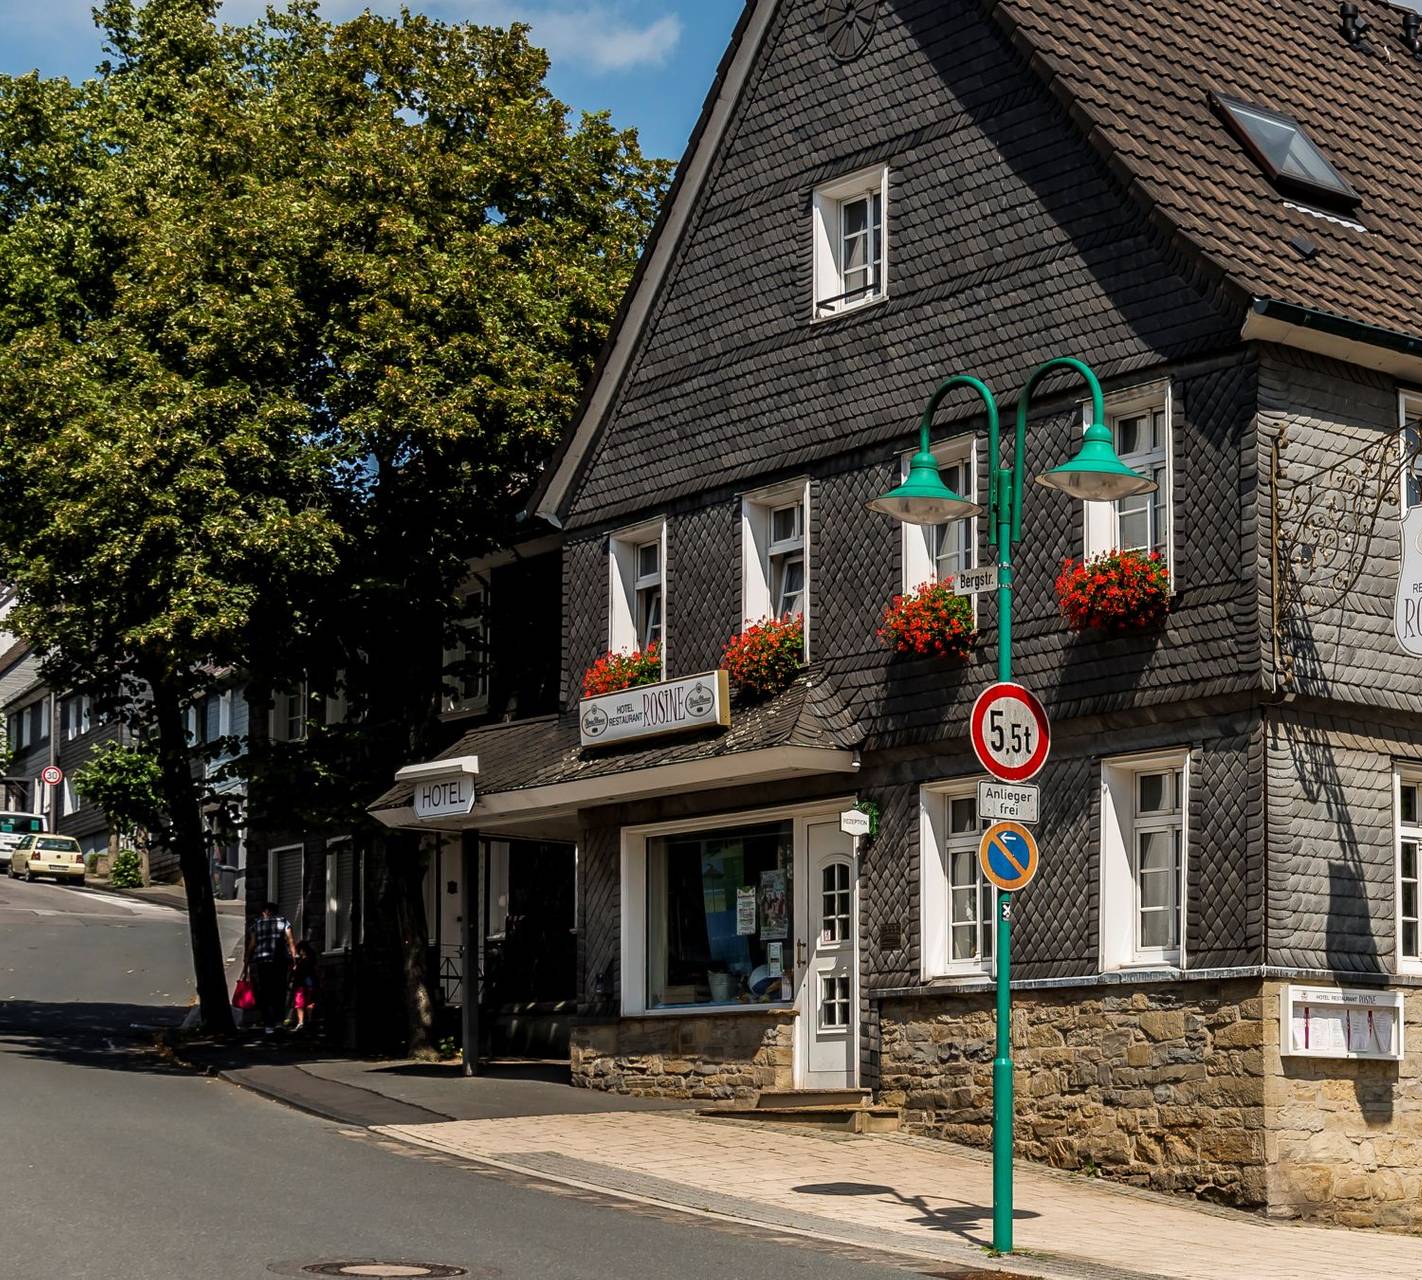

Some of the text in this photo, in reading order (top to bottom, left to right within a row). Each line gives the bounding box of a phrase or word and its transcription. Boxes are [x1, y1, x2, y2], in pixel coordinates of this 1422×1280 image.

[960, 571, 994, 590] Bergstr.
[616, 703, 635, 714] HOTEL
[608, 711, 643, 727] RESTAURANT
[46, 771, 57, 780] 30
[422, 781, 466, 809] HOTEL
[985, 788, 1032, 803] Anlieger
[1000, 802, 1019, 815] frei
